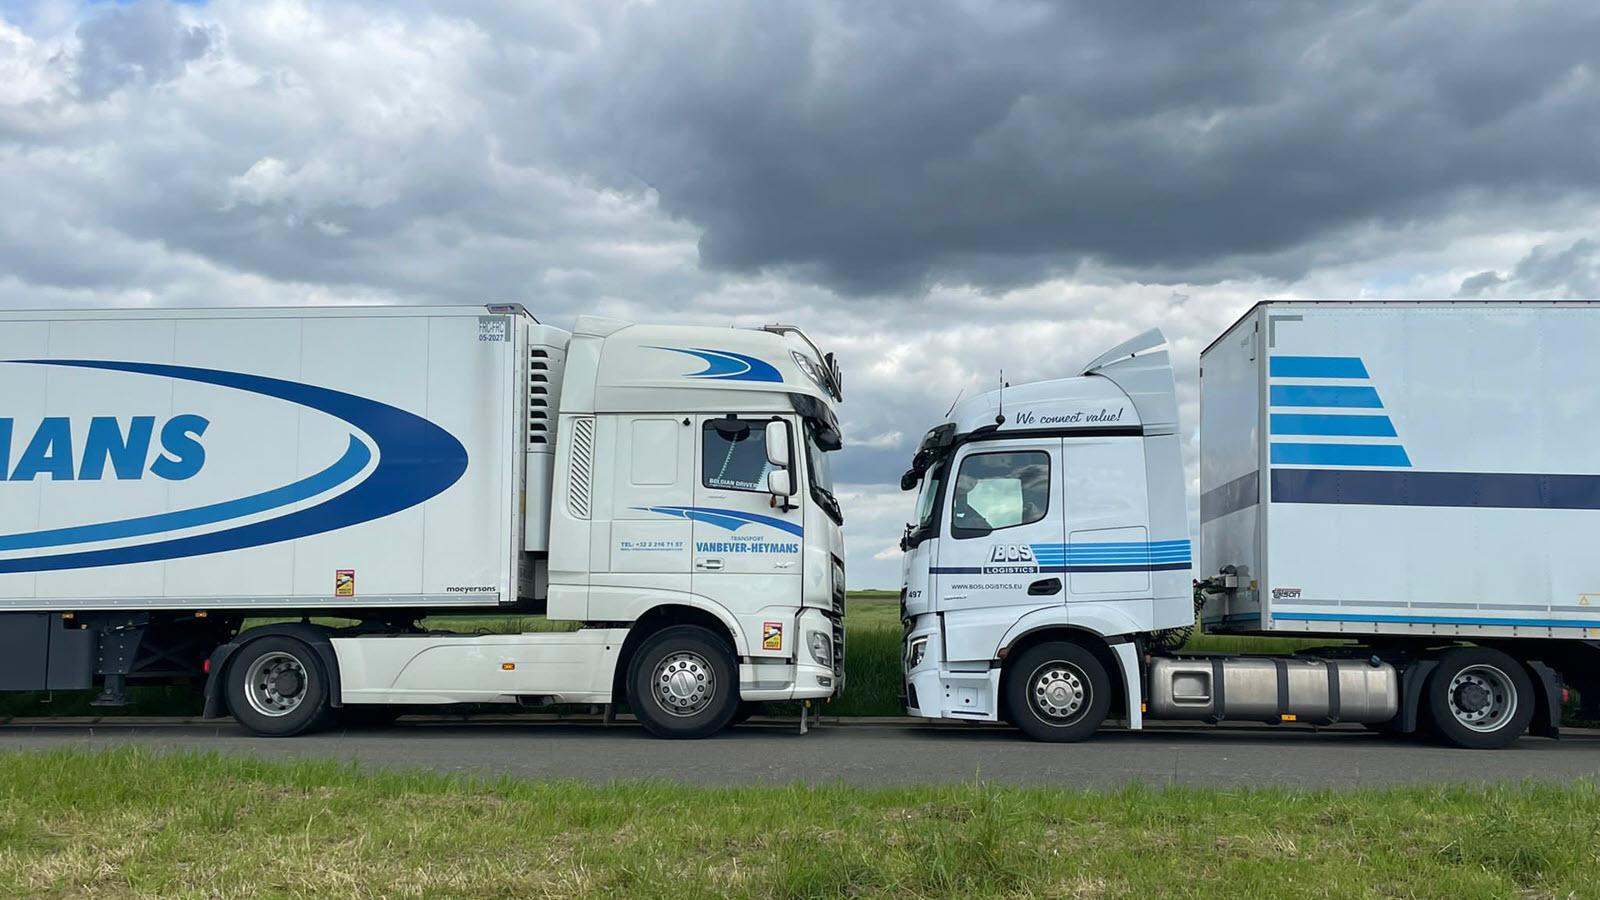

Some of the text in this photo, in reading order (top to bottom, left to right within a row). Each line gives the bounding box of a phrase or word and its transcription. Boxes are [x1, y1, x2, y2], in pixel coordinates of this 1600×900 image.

[479, 334, 504, 342] 05-2027
[1016, 407, 1124, 425] We connect value!
[0, 413, 211, 481] ANS
[696, 542, 799, 553] VANBEVER-HEYMANS
[446, 585, 497, 594] moeyersons
[908, 590, 922, 598] 497
